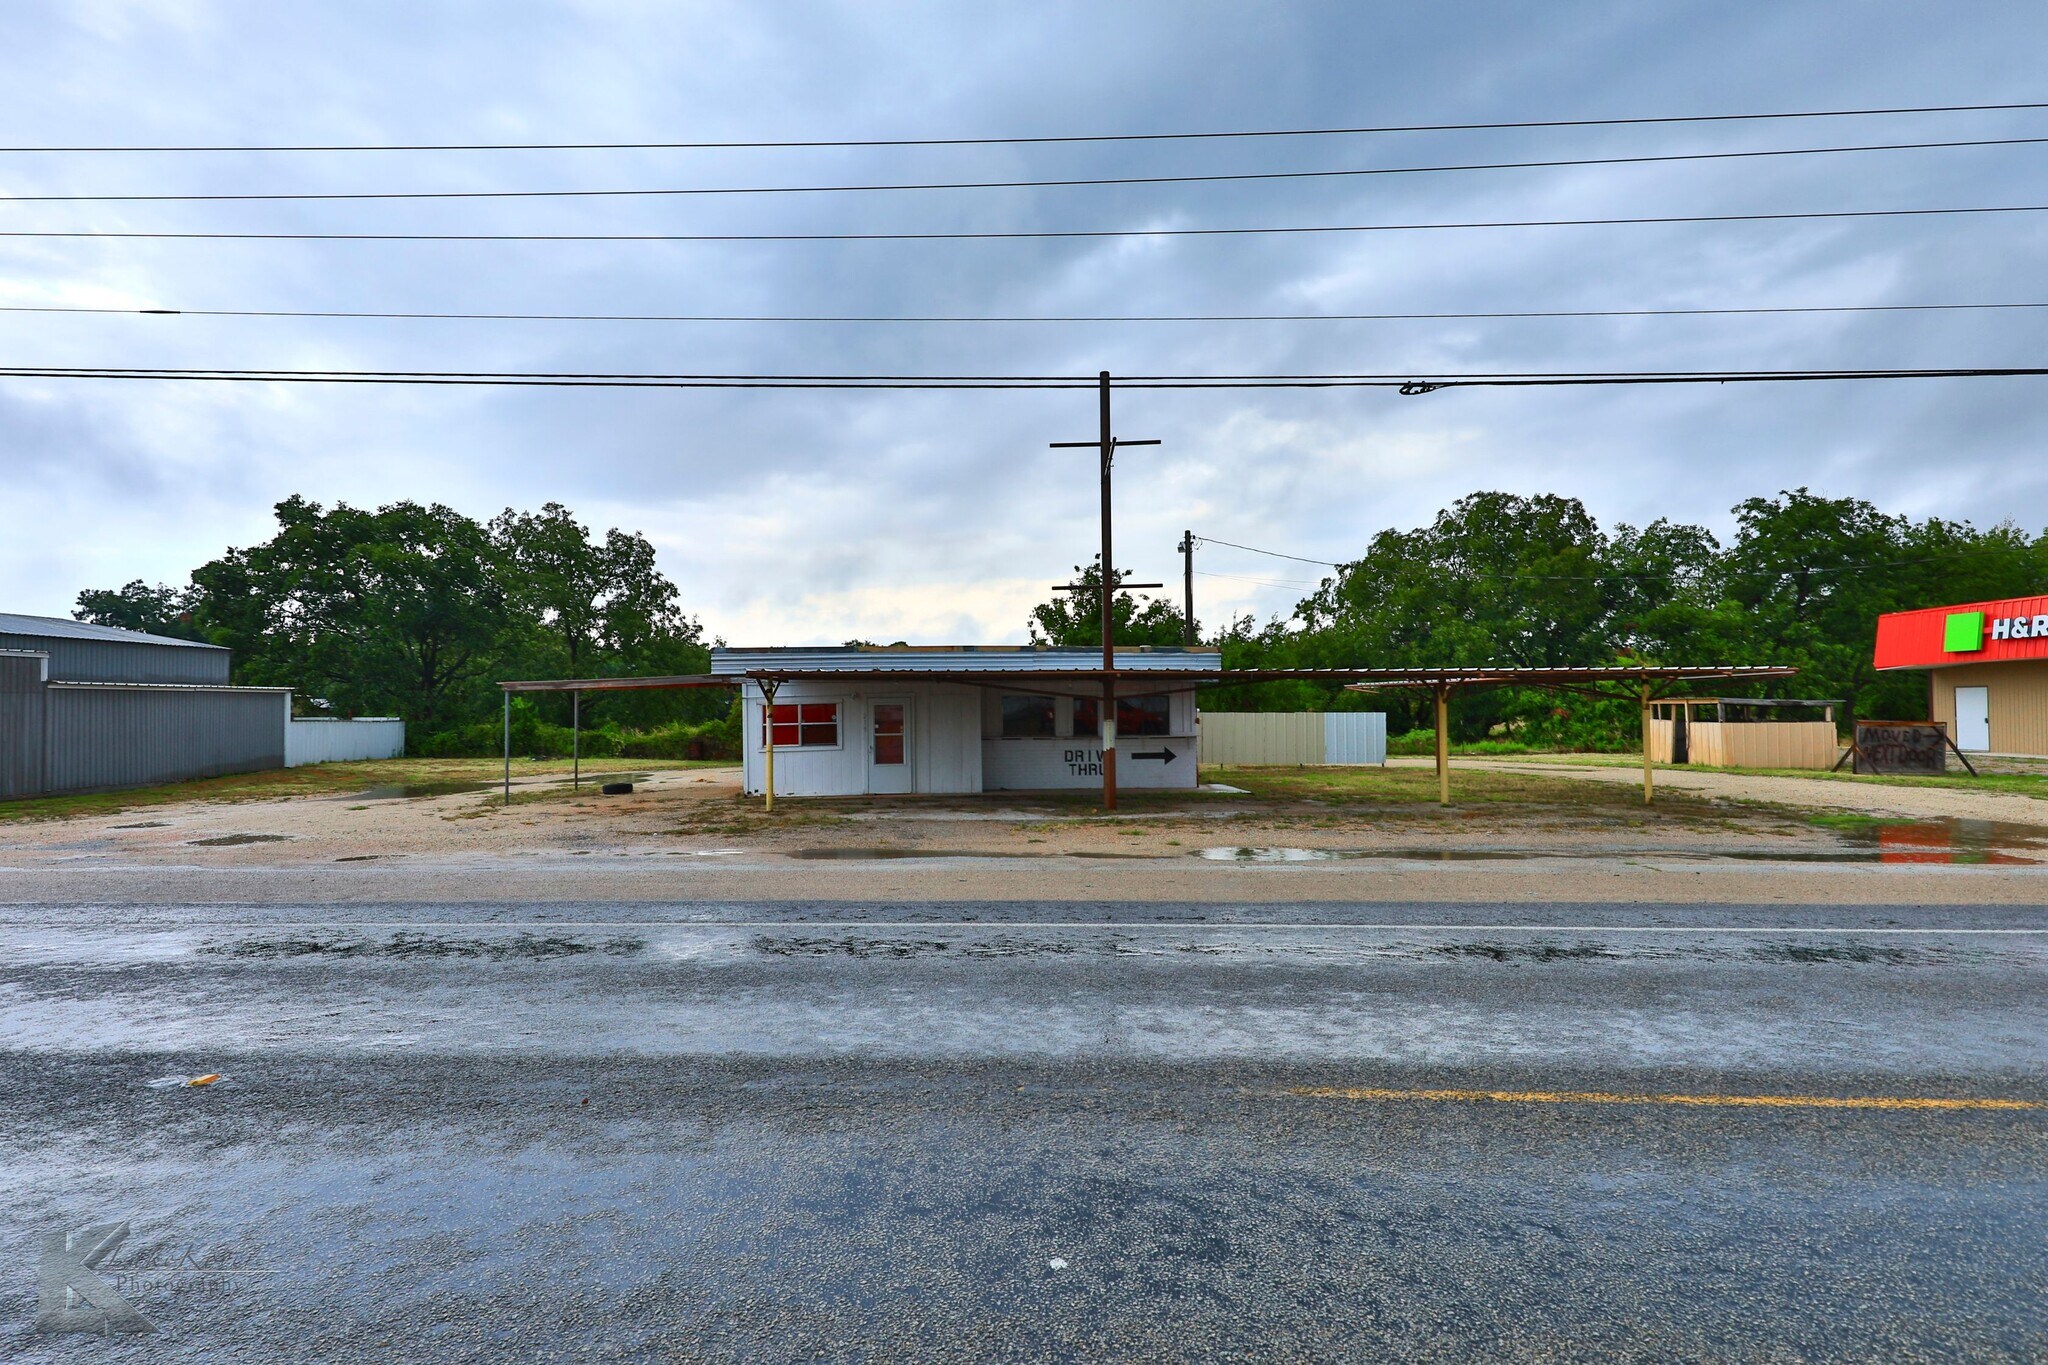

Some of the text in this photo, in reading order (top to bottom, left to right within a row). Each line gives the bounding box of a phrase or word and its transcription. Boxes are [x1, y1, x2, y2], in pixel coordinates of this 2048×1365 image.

[1991, 614, 2048, 640] H&R
[1862, 727, 1922, 743] MOVED
[1064, 749, 1104, 762] DRIV
